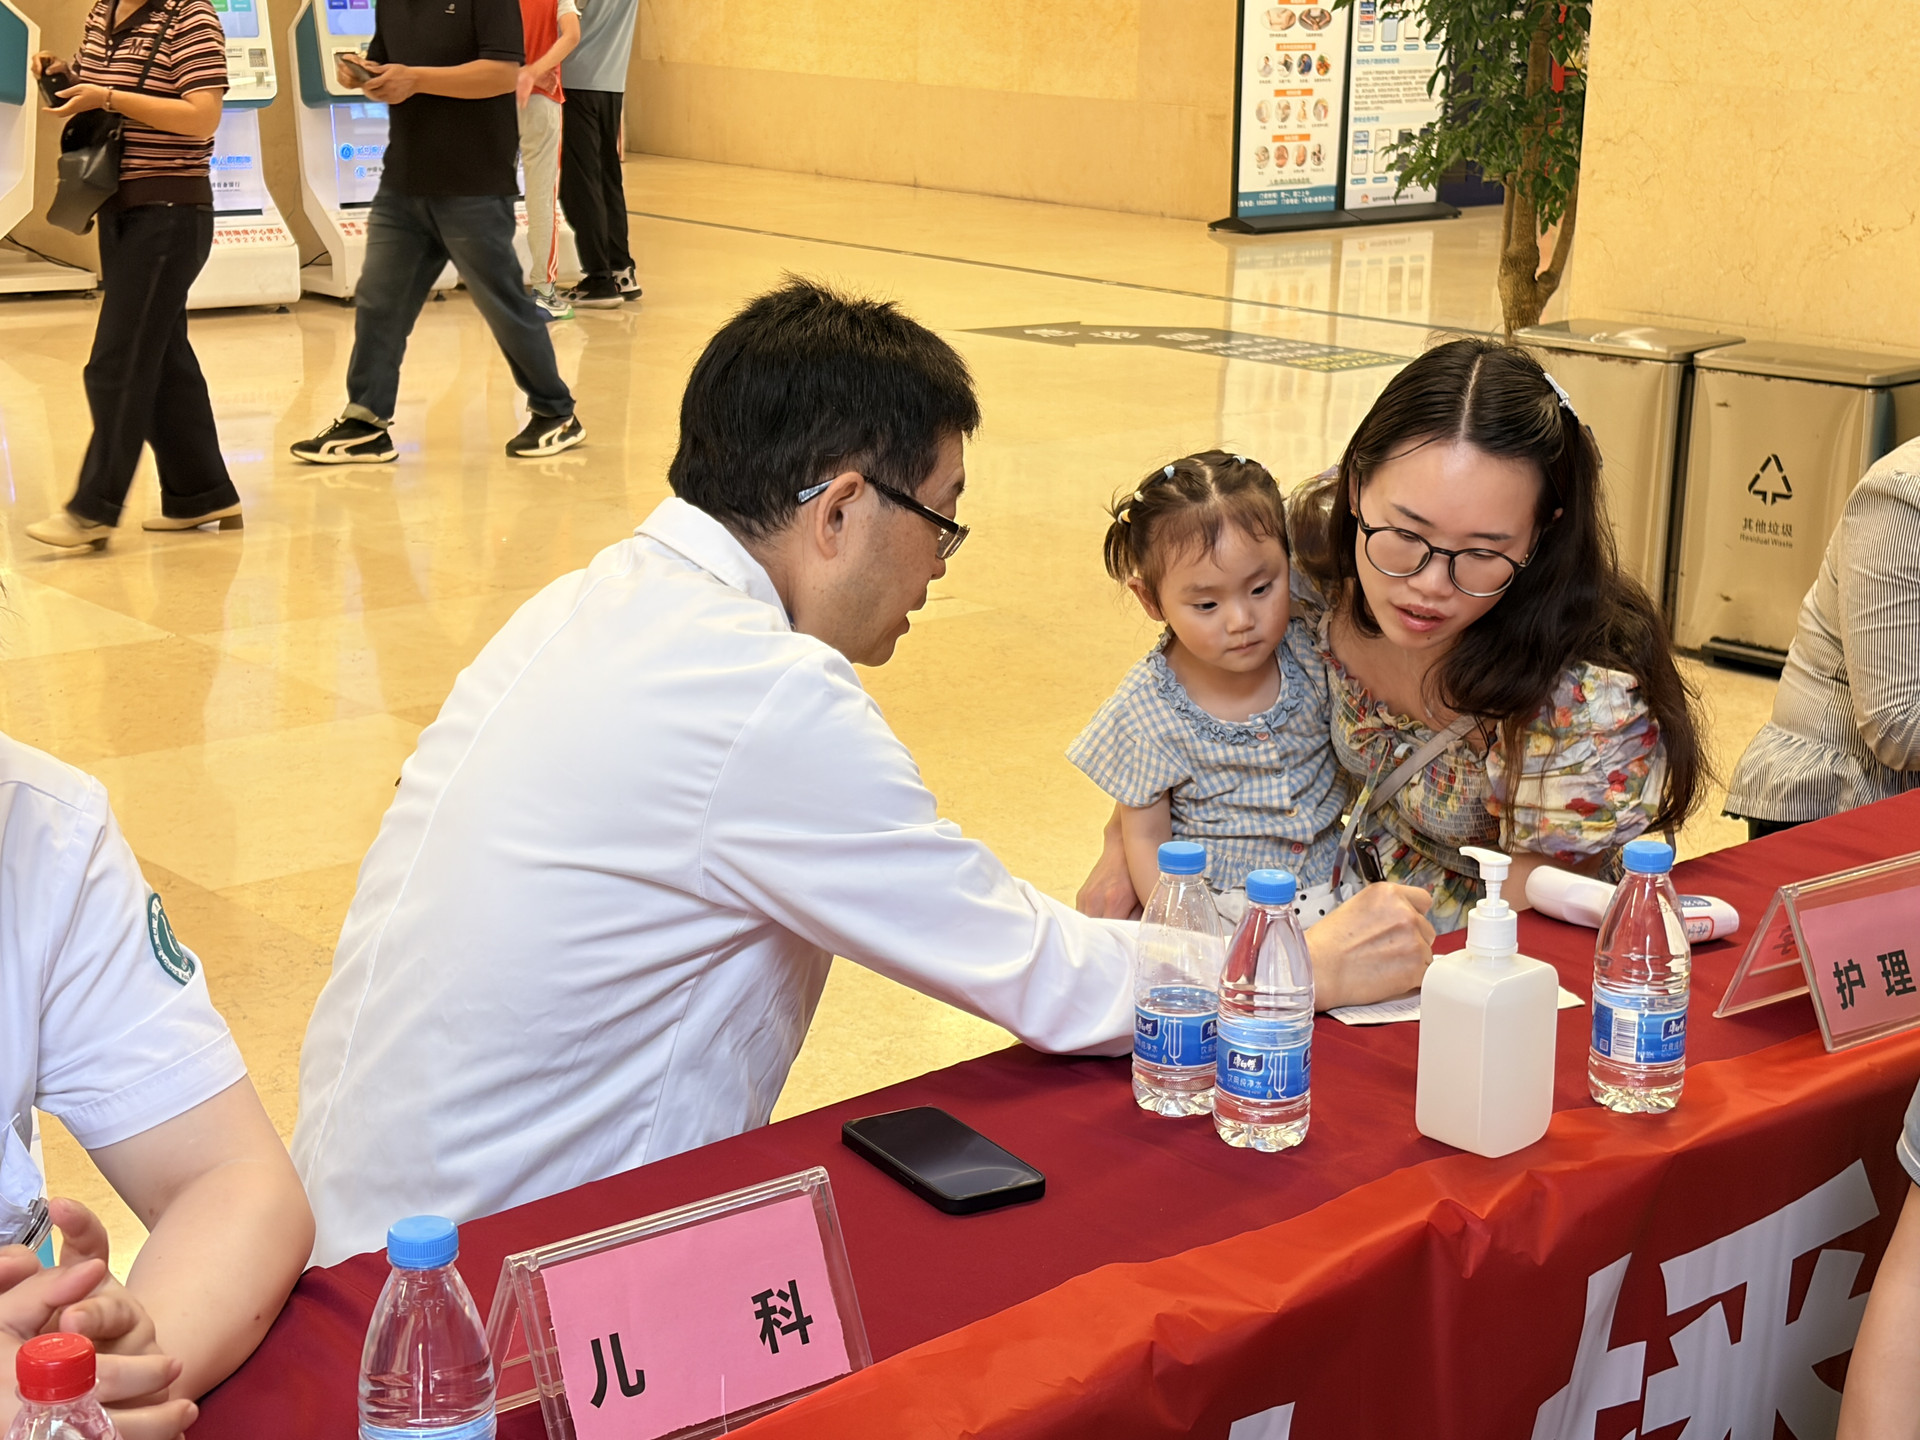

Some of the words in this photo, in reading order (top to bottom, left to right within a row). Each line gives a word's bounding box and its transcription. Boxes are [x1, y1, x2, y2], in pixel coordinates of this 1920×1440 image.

[1743, 517, 1792, 537] 其他垃圾
[1832, 949, 1917, 1010] 护理
